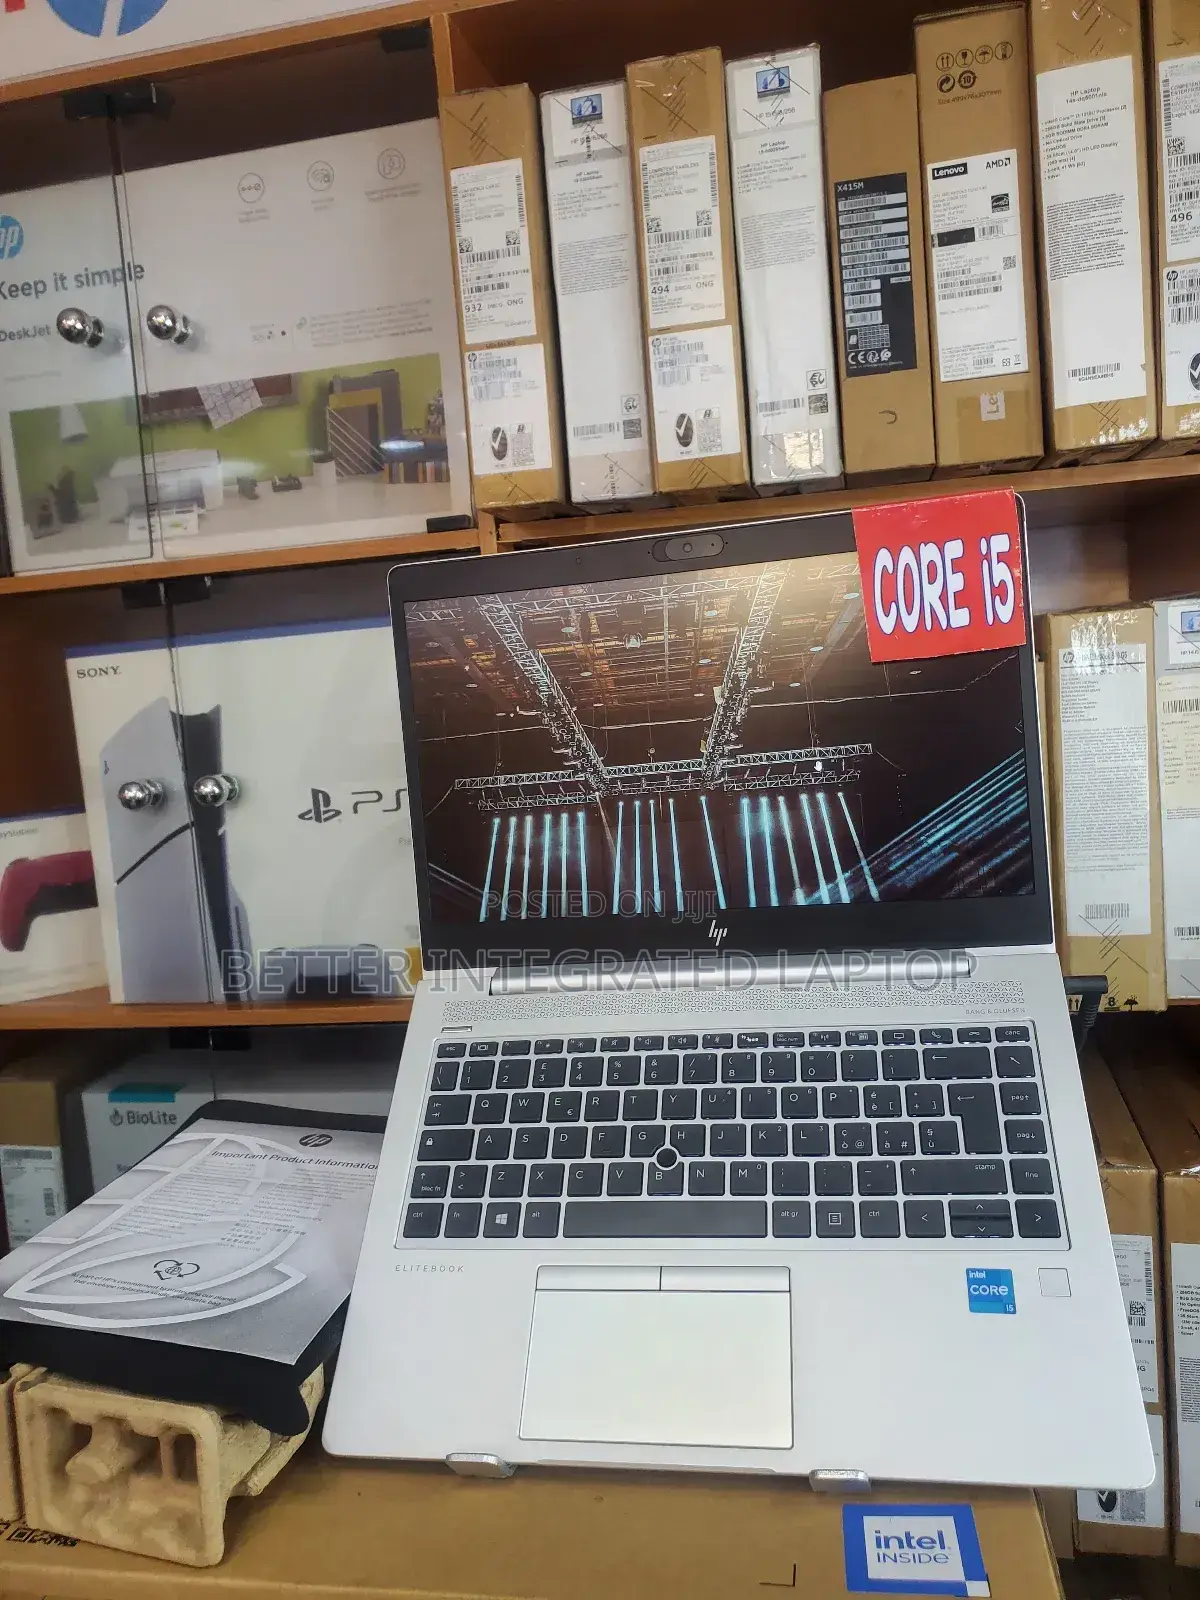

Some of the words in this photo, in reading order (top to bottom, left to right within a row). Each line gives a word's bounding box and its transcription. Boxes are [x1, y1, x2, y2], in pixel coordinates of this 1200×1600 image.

[934, 165, 965, 178] Lenovo
[985, 159, 1004, 170] AMD
[837, 182, 864, 193] X415M
[1170, 211, 1193, 223] 496
[53, 272, 69, 292] it
[74, 261, 145, 288] simple
[651, 284, 670, 295] 494
[696, 280, 714, 289] ONG
[464, 302, 483, 314] 932
[507, 298, 524, 307] ONG
[0, 324, 51, 342] DeskJet
[874, 539, 971, 635] CORE
[980, 533, 1015, 626] i5
[76, 665, 121, 679] SONY
[708, 920, 728, 946] hp
[554, 1097, 562, 1106] E
[592, 1097, 600, 1106] R
[630, 1095, 638, 1104] T
[669, 1094, 678, 1103] Y
[708, 1094, 717, 1103] U
[829, 1092, 838, 1102] P
[481, 1100, 490, 1109] Q
[518, 1098, 530, 1107] W
[126, 1109, 178, 1125] BioLite
[522, 1134, 529, 1143] S
[560, 1133, 568, 1142] D
[598, 1132, 606, 1141] F
[638, 1131, 647, 1140] G
[677, 1131, 686, 1140] H
[717, 1131, 724, 1140] J
[758, 1130, 767, 1139] K
[800, 1130, 807, 1139] L
[485, 1135, 493, 1144] A
[211, 1150, 268, 1161] Important
[269, 1154, 314, 1165] Product
[974, 1163, 996, 1172] stamp
[497, 1171, 505, 1181] Z
[536, 1171, 544, 1180] X
[575, 1170, 584, 1179] C
[615, 1169, 625, 1179] V
[655, 1171, 663, 1181] B
[696, 1169, 705, 1178] N
[738, 1168, 748, 1178] M
[790, 1210, 799, 1218] gr
[395, 1264, 464, 1273] ELITEBOOK
[969, 1270, 987, 1279] intel
[875, 1530, 947, 1550] intel
[877, 1552, 949, 1564] INSIDE
